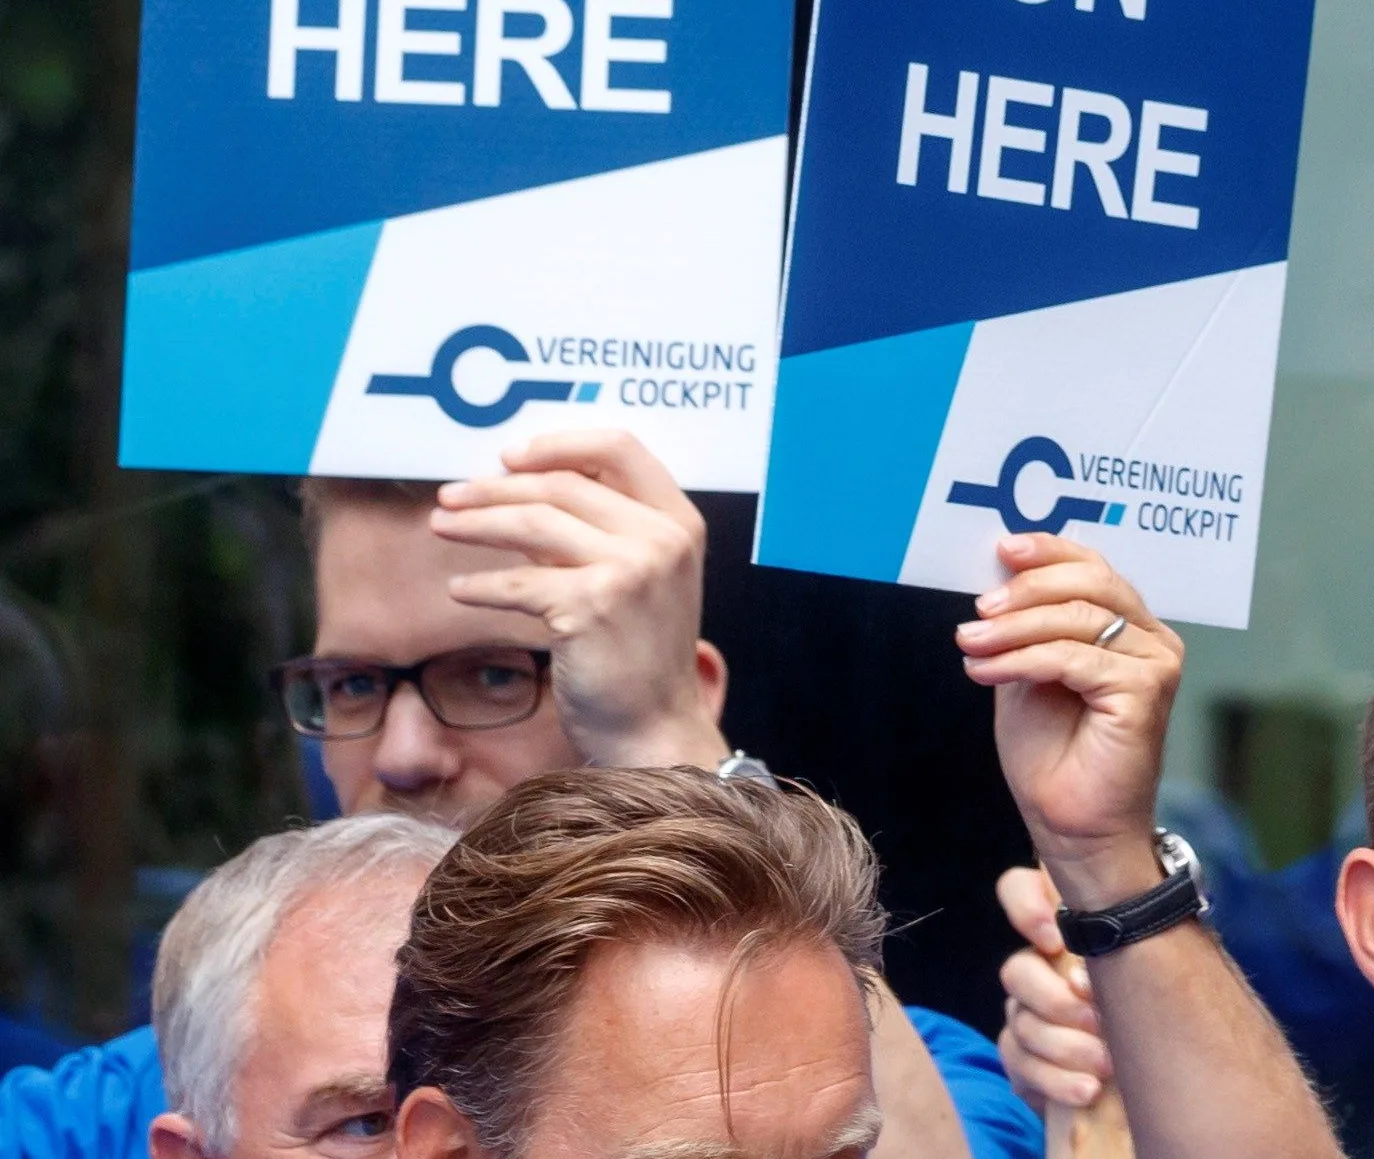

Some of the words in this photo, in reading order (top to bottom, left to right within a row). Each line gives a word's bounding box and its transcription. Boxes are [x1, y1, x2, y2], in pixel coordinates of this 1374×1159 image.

[896, 64, 1208, 228] HERE
[535, 337, 757, 372] VEREINIGUNG
[620, 379, 753, 410] COCKPIT
[1080, 454, 1243, 502] VEREINIGUNG
[1138, 502, 1239, 541] COCKPIT
